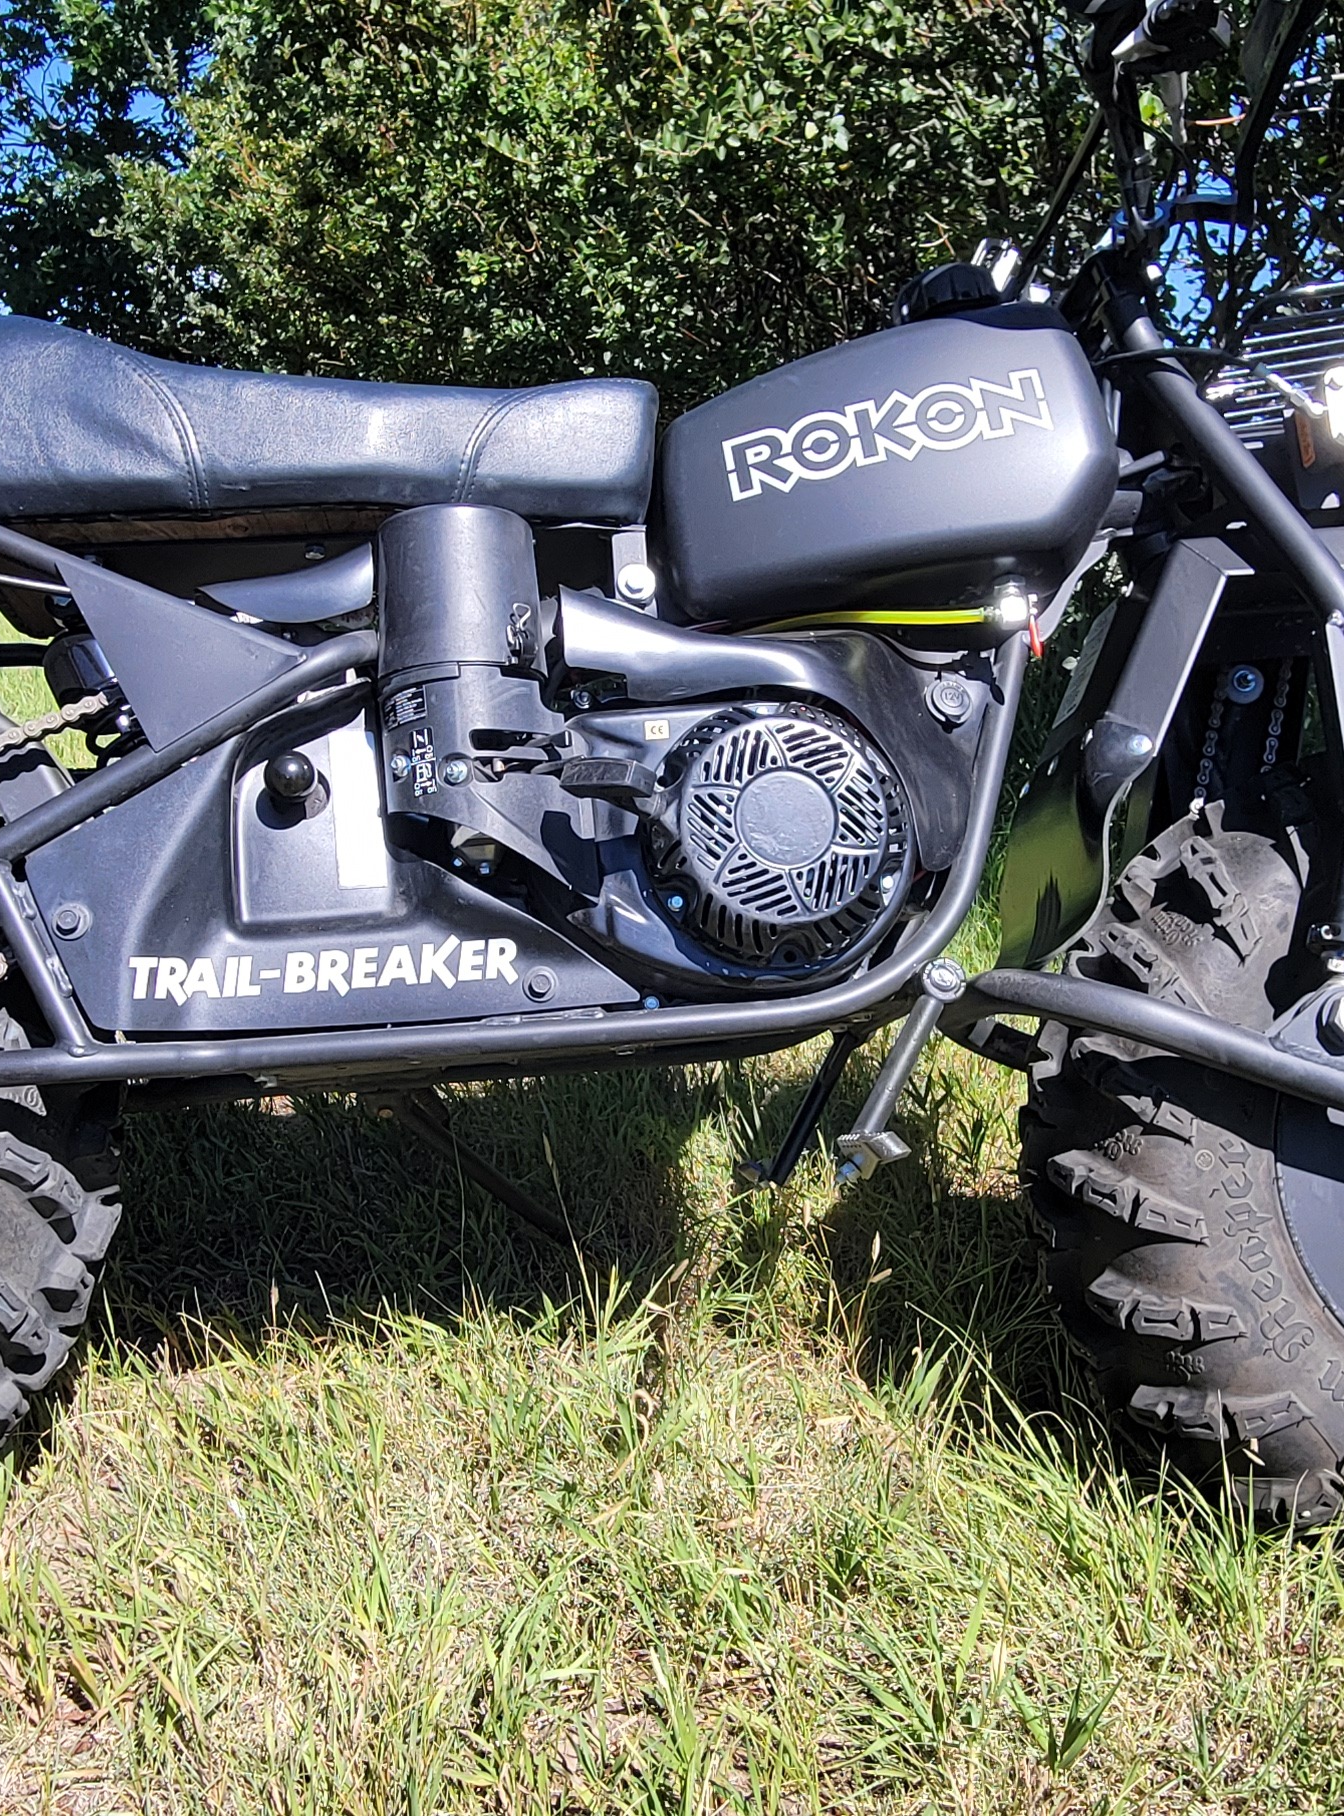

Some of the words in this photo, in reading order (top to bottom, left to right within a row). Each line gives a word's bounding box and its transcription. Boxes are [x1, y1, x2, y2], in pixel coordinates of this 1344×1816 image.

[721, 368, 1054, 502] ROKON
[128, 934, 518, 1006] TRAIL-BREAKER
[1218, 1138, 1314, 1362] Reaper
